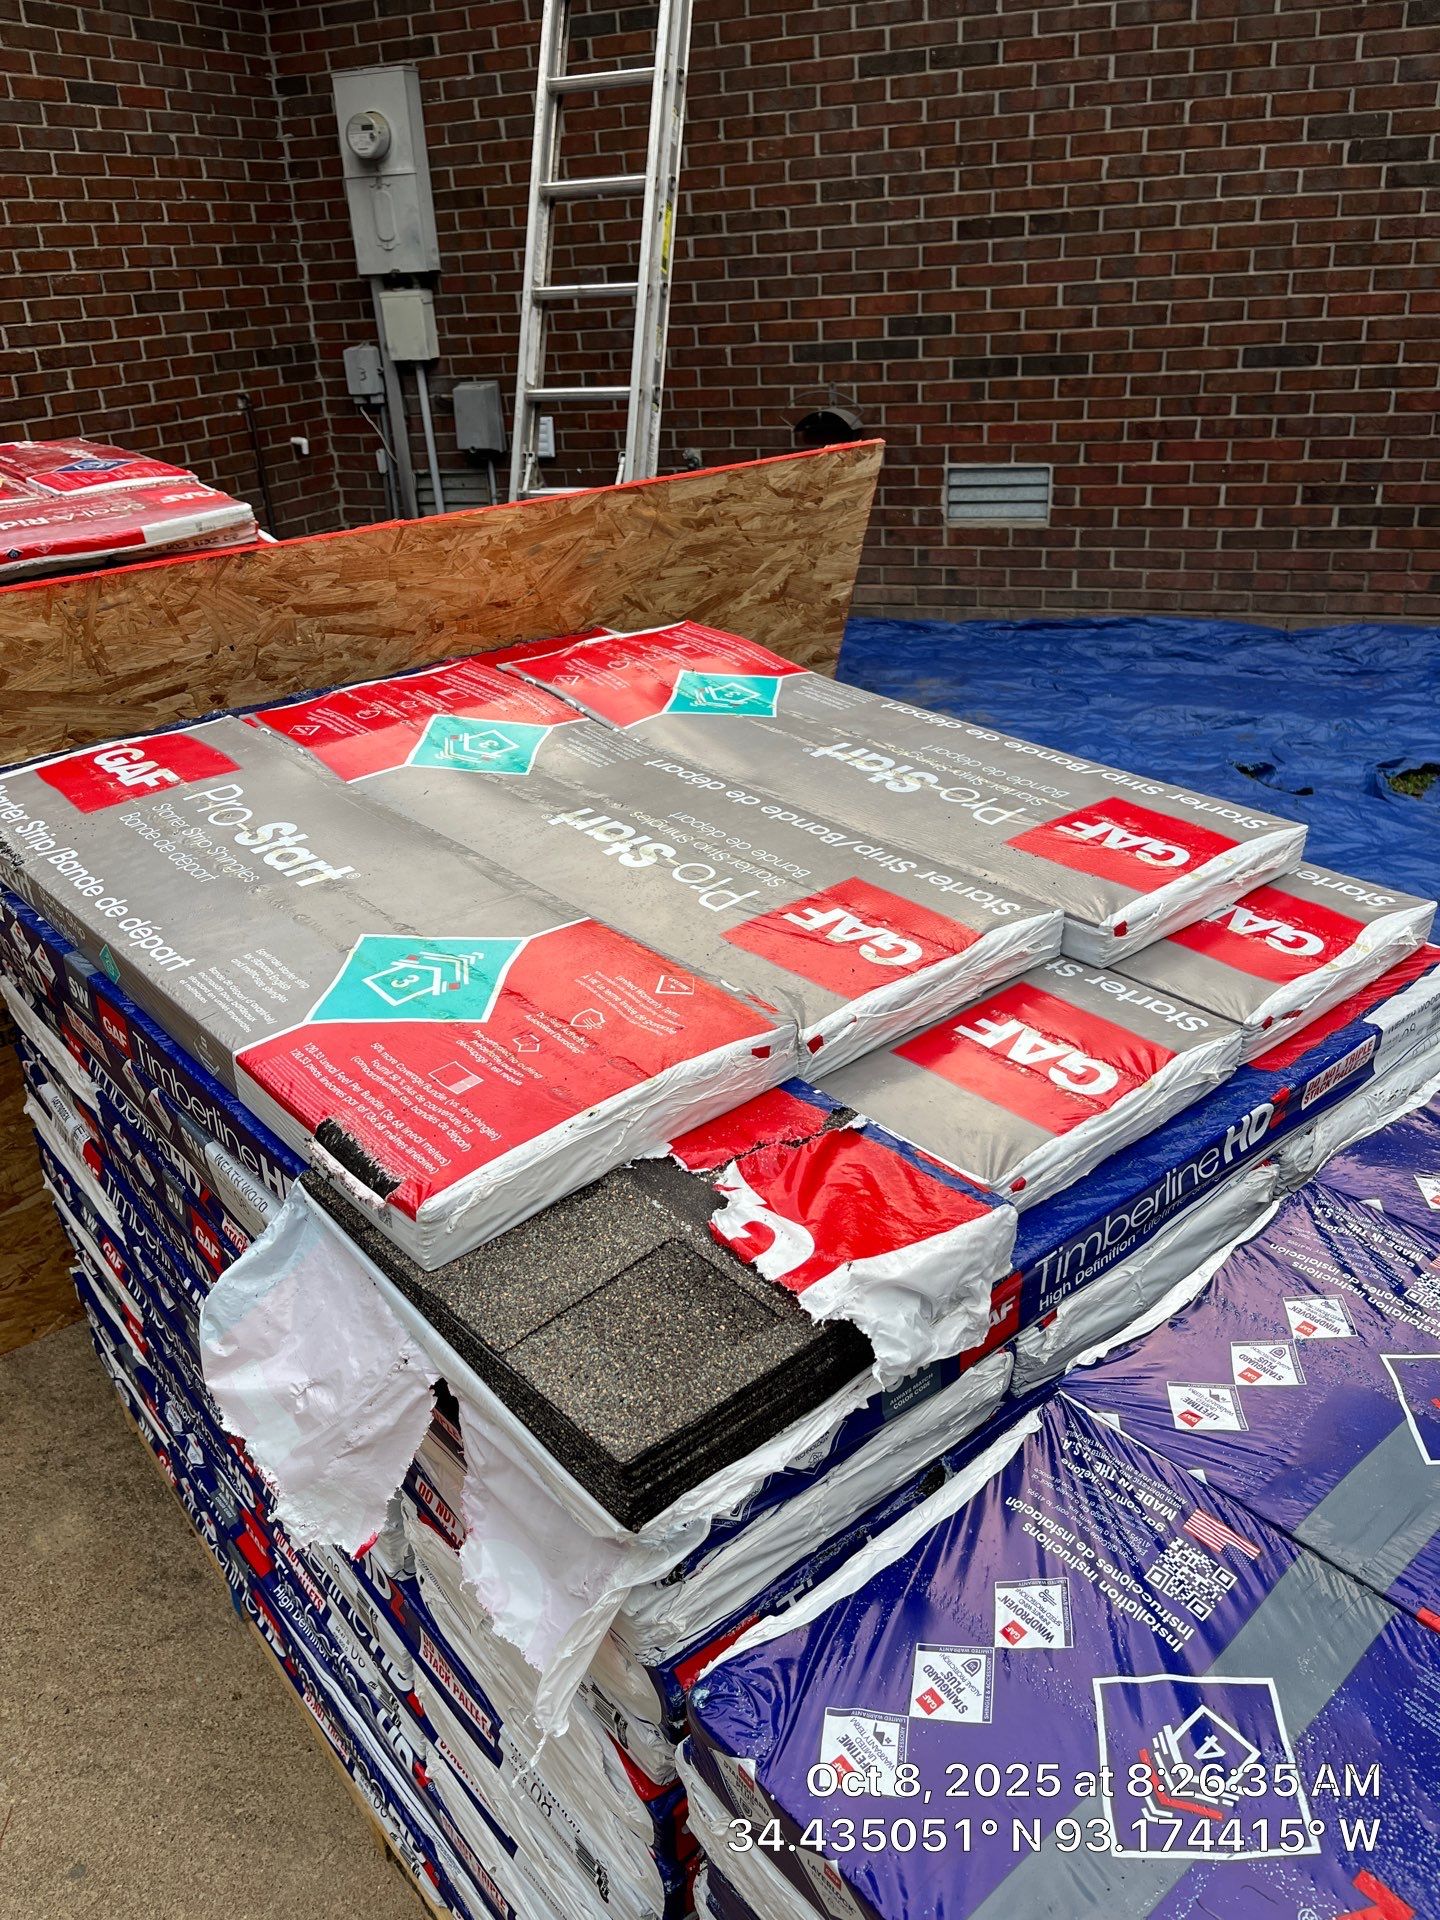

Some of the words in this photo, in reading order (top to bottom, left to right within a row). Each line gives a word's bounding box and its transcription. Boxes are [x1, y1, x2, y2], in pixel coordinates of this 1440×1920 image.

[880, 702, 962, 728] départ
[965, 728, 999, 741] de
[93, 747, 180, 787] GAF
[920, 744, 982, 767] départ
[643, 759, 726, 789] départ
[952, 769, 988, 785] Strip
[981, 765, 1006, 776] de
[725, 790, 760, 804] de
[986, 783, 1048, 805] Starter
[1005, 775, 1070, 798] Bande
[1165, 793, 1270, 828] Starter
[629, 811, 694, 843] Shingles
[667, 811, 726, 837] départ
[118, 811, 160, 840] Bande
[152, 839, 176, 852] de
[167, 852, 219, 882] départ
[151, 802, 190, 828] Starter
[181, 827, 212, 847] Strip
[206, 845, 259, 882] Shingles
[692, 841, 730, 861] Strip
[725, 837, 751, 849] de
[1054, 821, 1190, 867] GAF
[726, 859, 786, 887] Starter
[750, 849, 811, 878] Bande
[913, 870, 1020, 915] Starter
[95, 896, 129, 918] de
[118, 917, 197, 972] départ
[781, 907, 922, 965] GAF
[68, 975, 90, 1009] SW
[390, 974, 419, 987] 3
[1084, 975, 1208, 1031] Starter
[102, 1015, 127, 1047] GAF
[289, 1048, 311, 1064] 120.33
[953, 1018, 1118, 1095] GAF
[1307, 1076, 1321, 1093] DO
[1323, 1061, 1342, 1082] NOT
[1345, 1038, 1373, 1067] TRIPLE
[303, 1063, 322, 1077] pieds
[1303, 1078, 1330, 1105] STACK
[1332, 1050, 1370, 1084] PALLETS
[318, 1075, 347, 1098] linéaires
[380, 1051, 398, 1064] more
[458, 1106, 473, 1118] strip
[471, 1116, 501, 1141] shingles)
[401, 1084, 417, 1095] plus
[132, 1031, 261, 1175] Timberline
[303, 1042, 324, 1059] 120.33
[334, 1071, 353, 1084] Feet
[348, 1082, 363, 1092] Per
[360, 1089, 384, 1110] Bundle
[379, 1109, 404, 1128] (36.68
[400, 1126, 427, 1143] lineal
[421, 1141, 451, 1166] meters)
[342, 1095, 359, 1106] par
[350, 1055, 403, 1096] (comparativement
[399, 1095, 413, 1107] aux
[410, 1104, 440, 1123] bandes
[446, 1129, 471, 1152] départ)
[355, 1103, 370, 1113] lot
[362, 1111, 386, 1130] (36.68
[404, 1146, 439, 1174] linéaires)
[1034, 1147, 1219, 1294] Timberline
[194, 1225, 221, 1259] GAF
[1269, 1243, 1340, 1279] instalación
[1291, 1261, 1365, 1298] instructions
[1341, 1272, 1359, 1283] de
[1039, 1281, 1071, 1311] High
[1299, 1323, 1312, 1333] GAF
[1238, 1352, 1283, 1381] STAINGUARD
[1242, 1369, 1256, 1380] GAF
[911, 1372, 933, 1389] MATCH
[892, 1392, 914, 1409] COLOR
[913, 1380, 930, 1394] CODE
[1182, 1396, 1219, 1420] LIFETIME
[1092, 1460, 1117, 1481] THE
[1119, 1469, 1132, 1479] AND
[418, 1481, 434, 1504] DO
[1026, 1487, 1045, 1501] 41595
[1117, 1477, 1134, 1491] IN
[1132, 1474, 1165, 1502] DOMESTIC
[1134, 1488, 1177, 1521] MADE
[1164, 1495, 1181, 1509] WITH
[1005, 1496, 1075, 1549] instalación
[1070, 1515, 1082, 1526] text
[1078, 1513, 1091, 1525] with
[1022, 1522, 1098, 1580] instructions
[1075, 1541, 1094, 1558] de
[1089, 1531, 1107, 1546] Code
[1128, 1532, 1151, 1547] 41595
[273, 1582, 295, 1614] High
[1017, 1597, 1033, 1611] WIND
[1095, 1557, 1194, 1640] Instrucciones
[1030, 1608, 1050, 1626] INFINITE
[1044, 1611, 1062, 1627] SPEED
[1098, 1579, 1184, 1652] Installation
[1004, 1623, 1021, 1640] GAF
[422, 1645, 451, 1688] STACK
[918, 1663, 971, 1715] STAINGUARD
[920, 1692, 939, 1710] GAF
[964, 1680, 983, 1698] ALGAE
[848, 1717, 868, 1736] TERM
[852, 1735, 878, 1762] LIMITED
[861, 1734, 897, 1770] WARRANTY
[1194, 1735, 1226, 1759] 4
